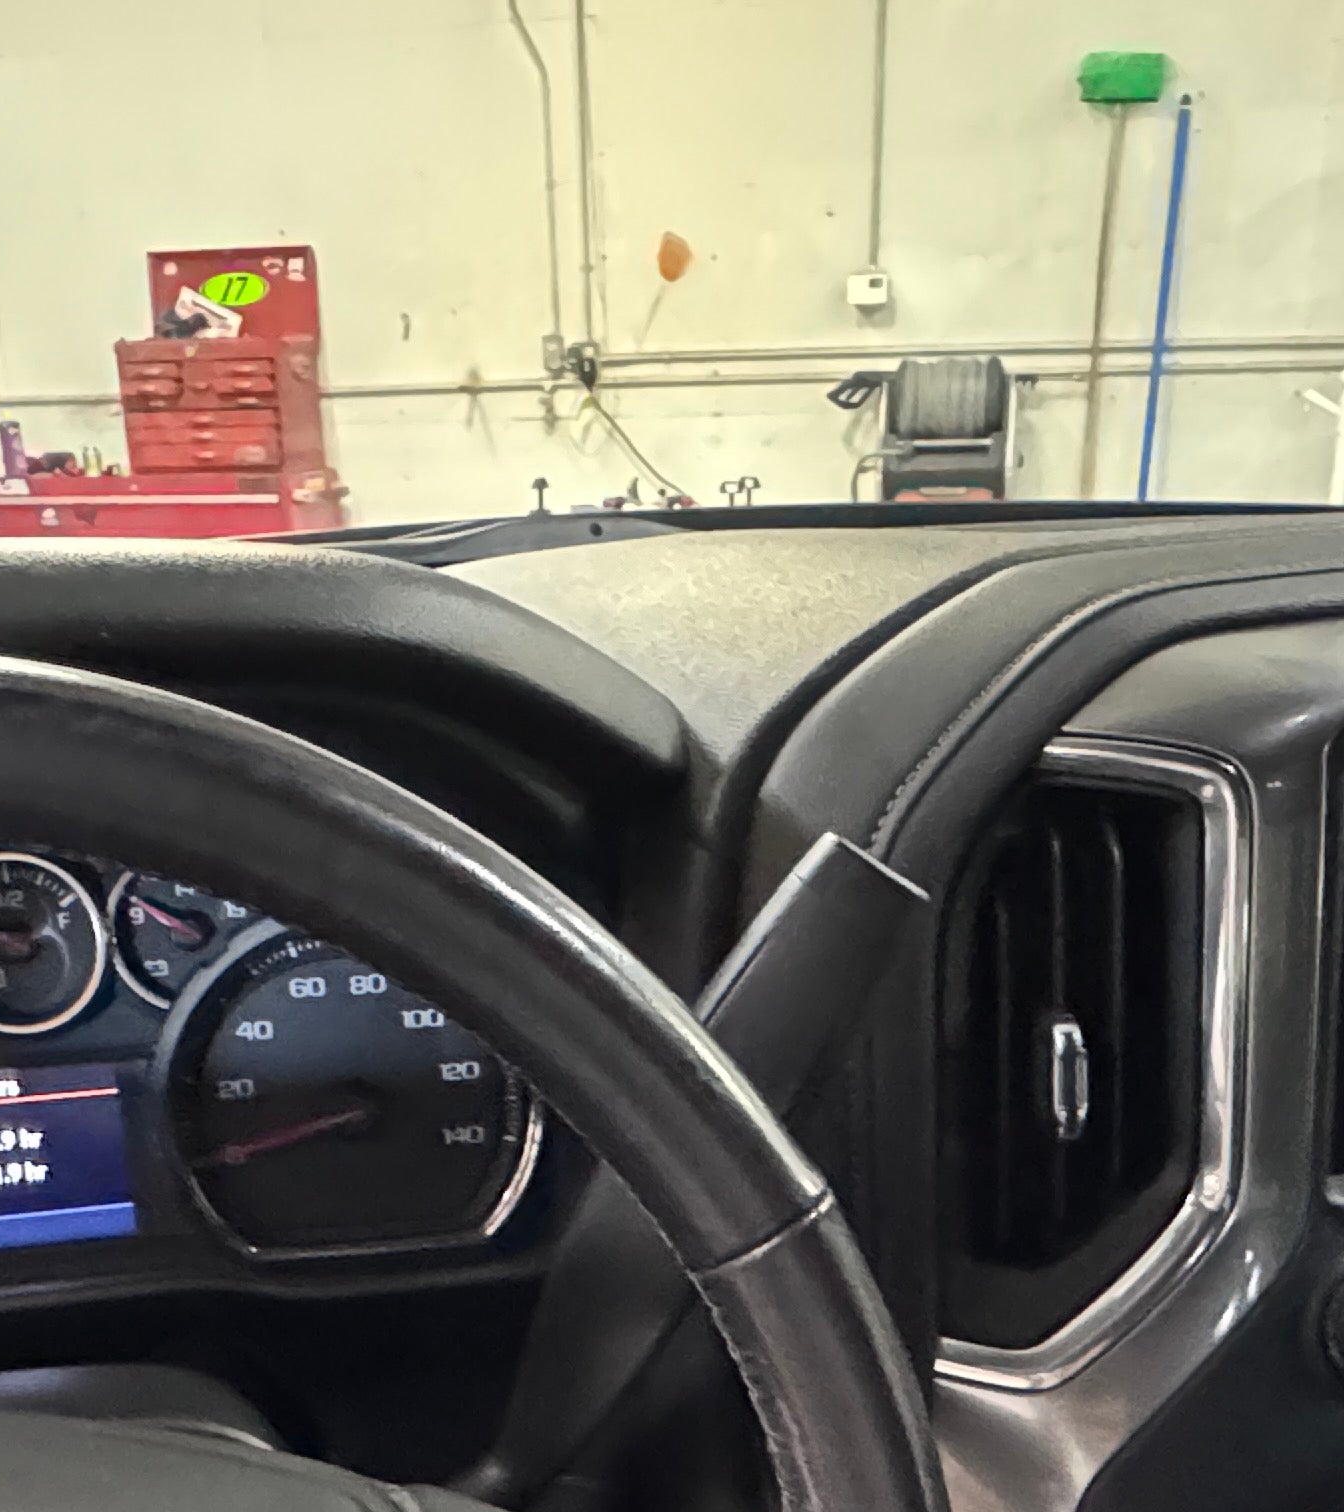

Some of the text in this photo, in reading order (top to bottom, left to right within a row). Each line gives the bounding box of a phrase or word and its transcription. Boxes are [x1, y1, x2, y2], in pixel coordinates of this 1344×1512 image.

[221, 276, 249, 302] 17
[288, 976, 327, 999] 60
[349, 972, 388, 996] 80
[400, 1008, 447, 1029] 100
[234, 1019, 275, 1042] 40
[438, 1060, 481, 1082] 120
[217, 1078, 256, 1101] 20
[18, 1127, 44, 1150] hr
[24, 1160, 50, 1183] hr
